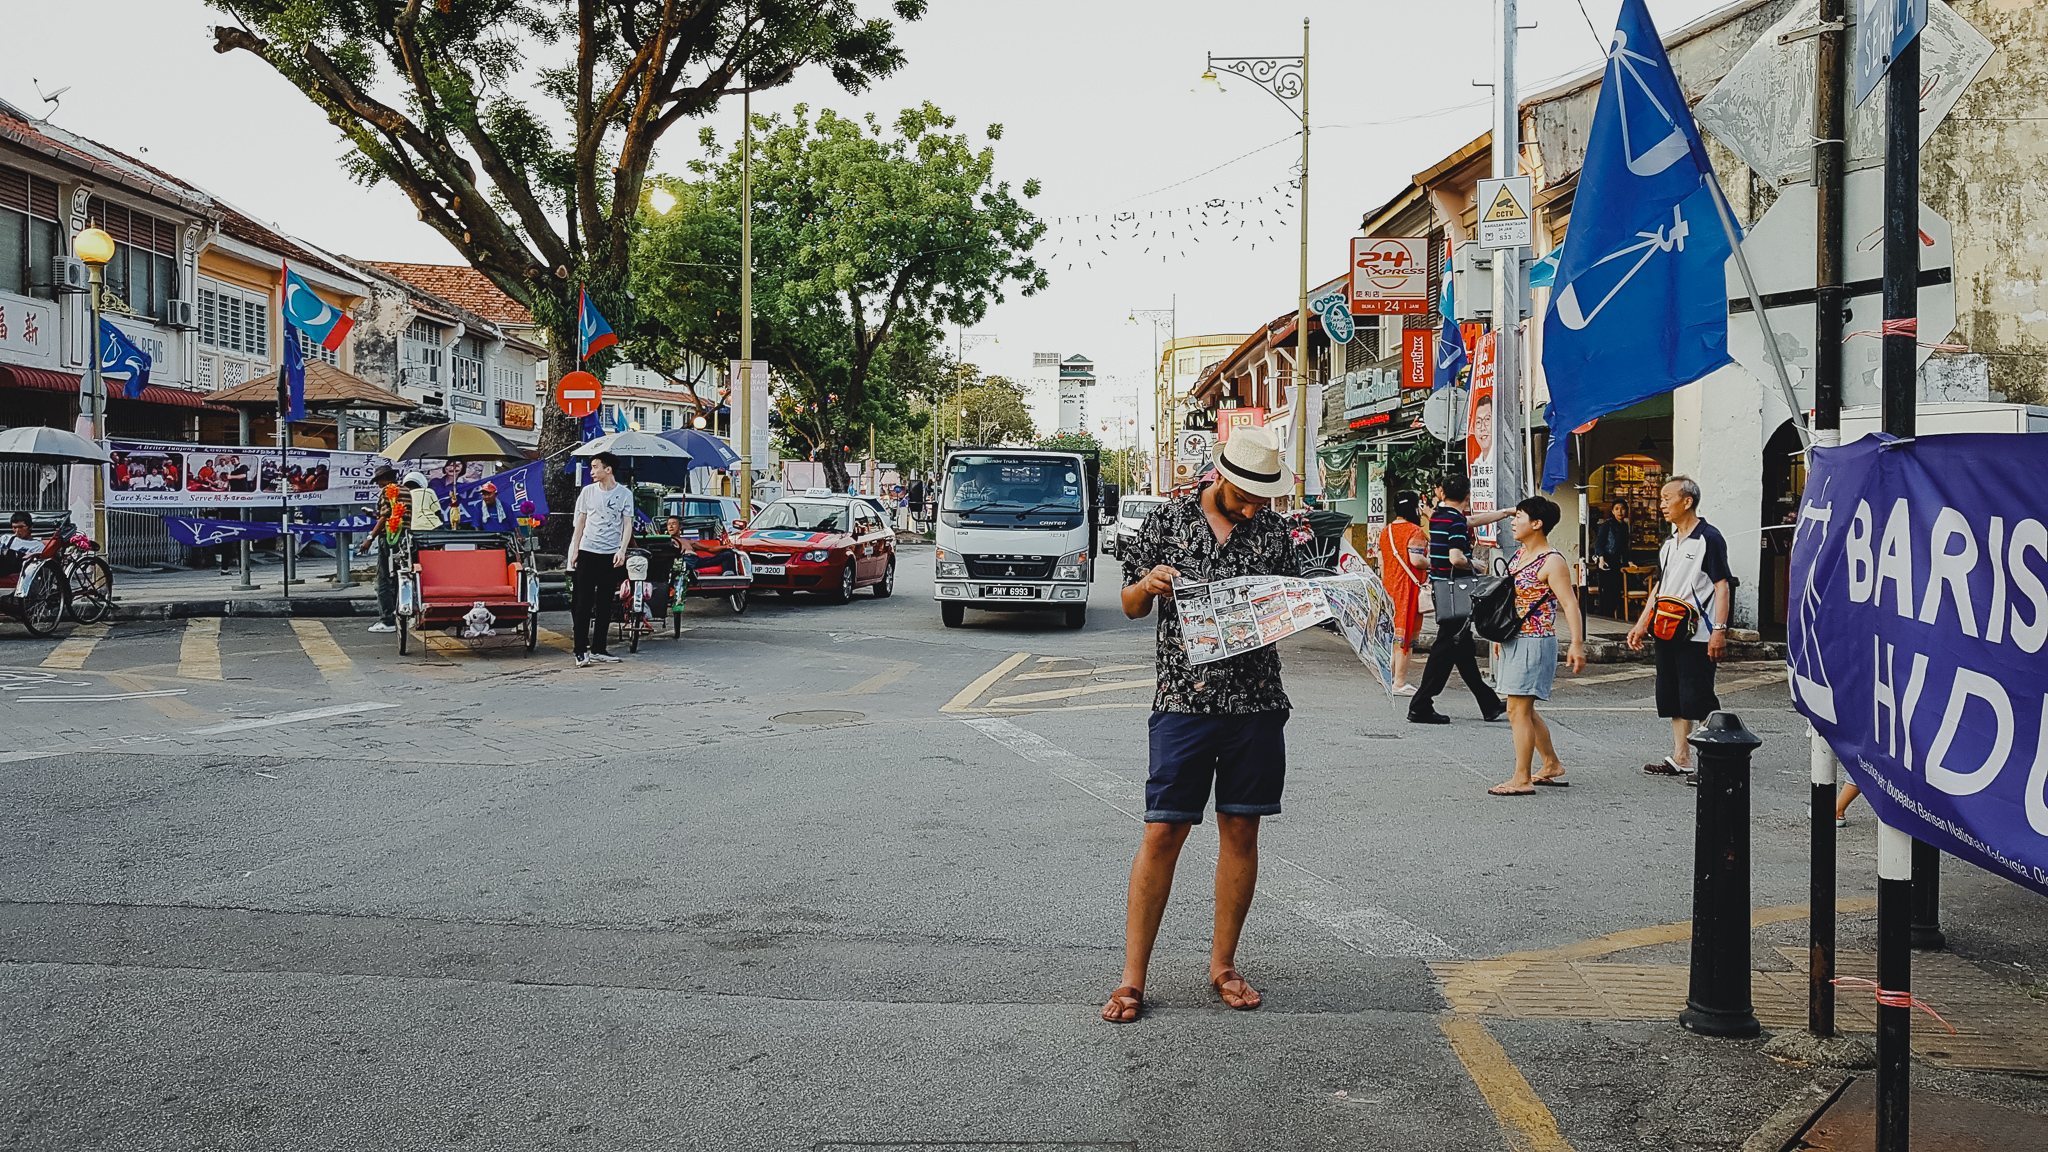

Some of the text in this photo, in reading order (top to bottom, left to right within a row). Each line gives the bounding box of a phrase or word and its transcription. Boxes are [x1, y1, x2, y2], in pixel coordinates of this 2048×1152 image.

[1865, 0, 1914, 78] SEHALA
[1496, 210, 1514, 218] CCTV
[1357, 251, 1410, 268] 24
[1384, 301, 1400, 311] 24
[340, 467, 361, 477] NG
[1371, 498, 1383, 513] 88
[992, 587, 1028, 596] PMY 6993
[1917, 803, 1949, 832] Barisan
